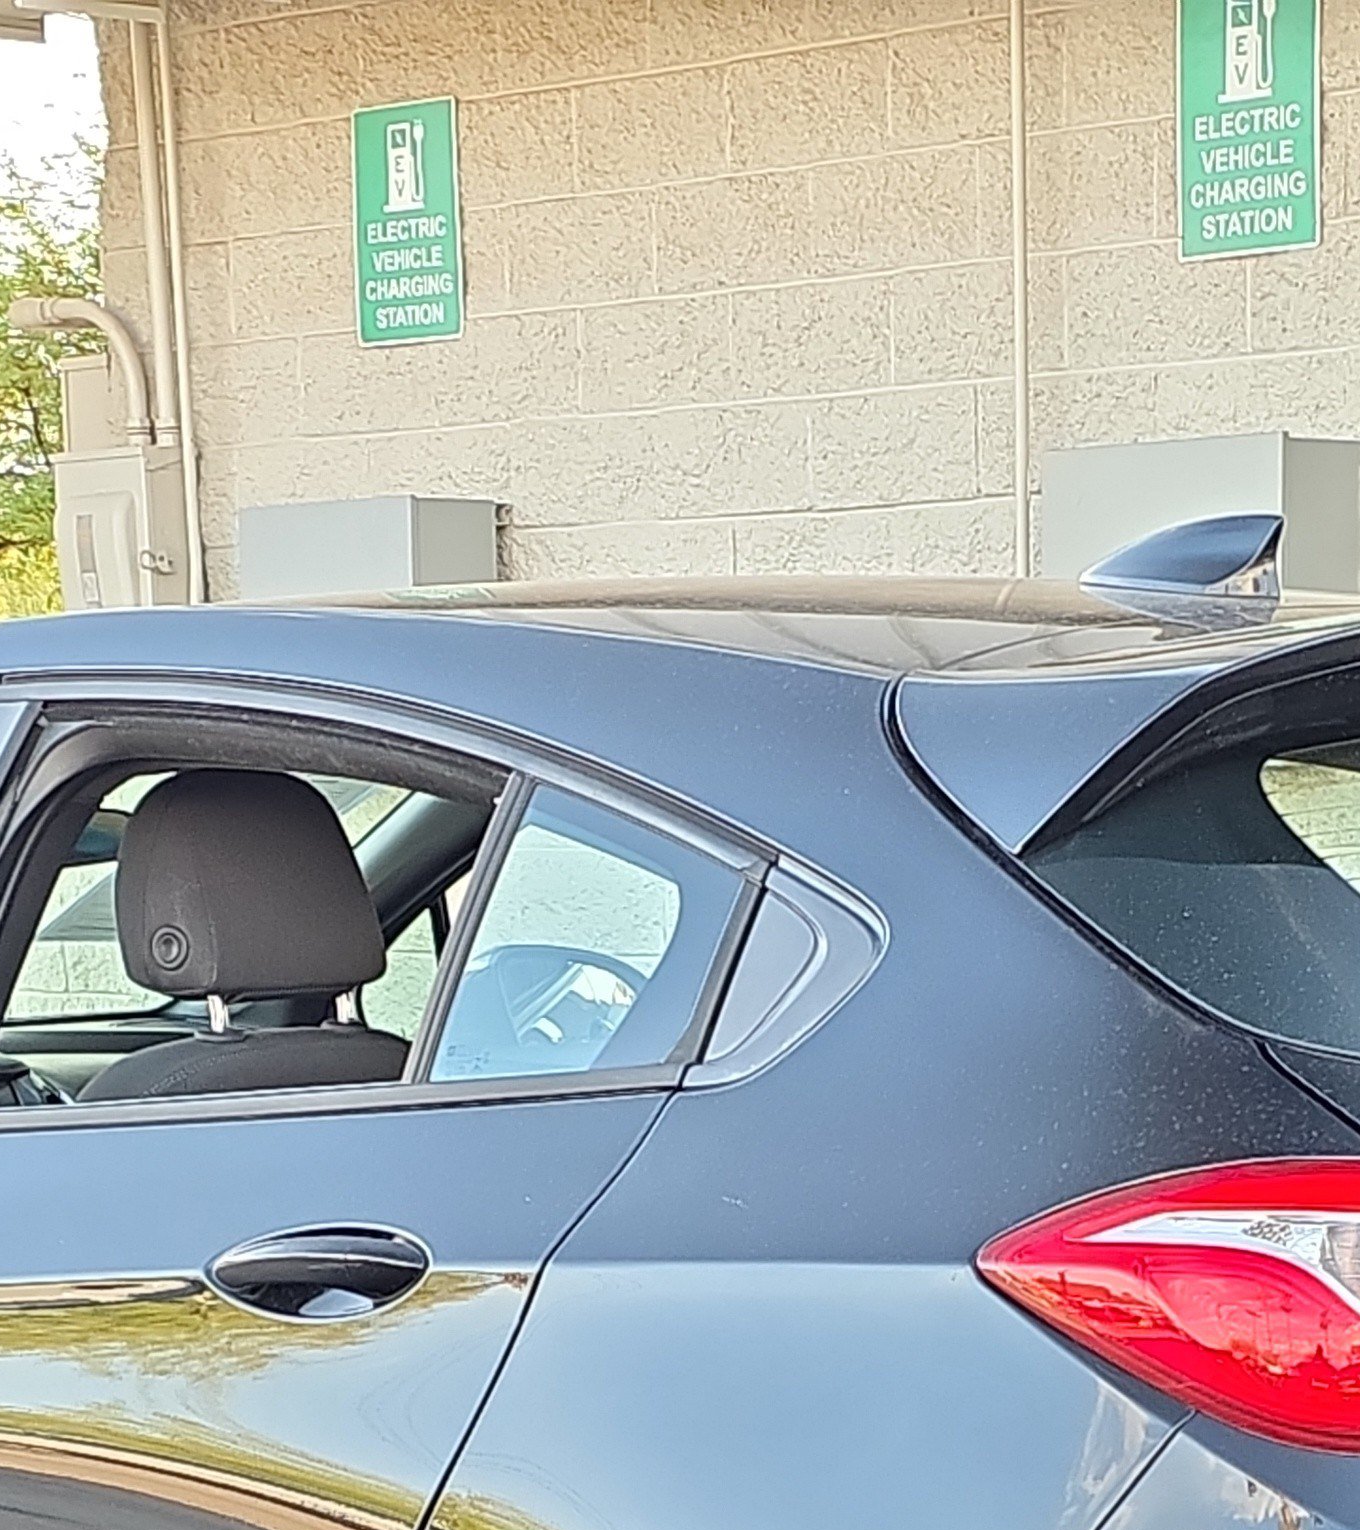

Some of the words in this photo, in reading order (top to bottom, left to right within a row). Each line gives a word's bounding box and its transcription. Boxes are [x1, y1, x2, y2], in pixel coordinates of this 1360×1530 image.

[1194, 103, 1302, 141] ELECTRIC
[1200, 139, 1295, 174] VEHICLE
[1190, 170, 1307, 209] CHARGING
[367, 214, 447, 244] ELECTRIC
[1201, 205, 1293, 240] STATION
[372, 245, 443, 273] VEHICLE
[365, 272, 454, 301] CHARGING
[376, 301, 445, 330] STATION
